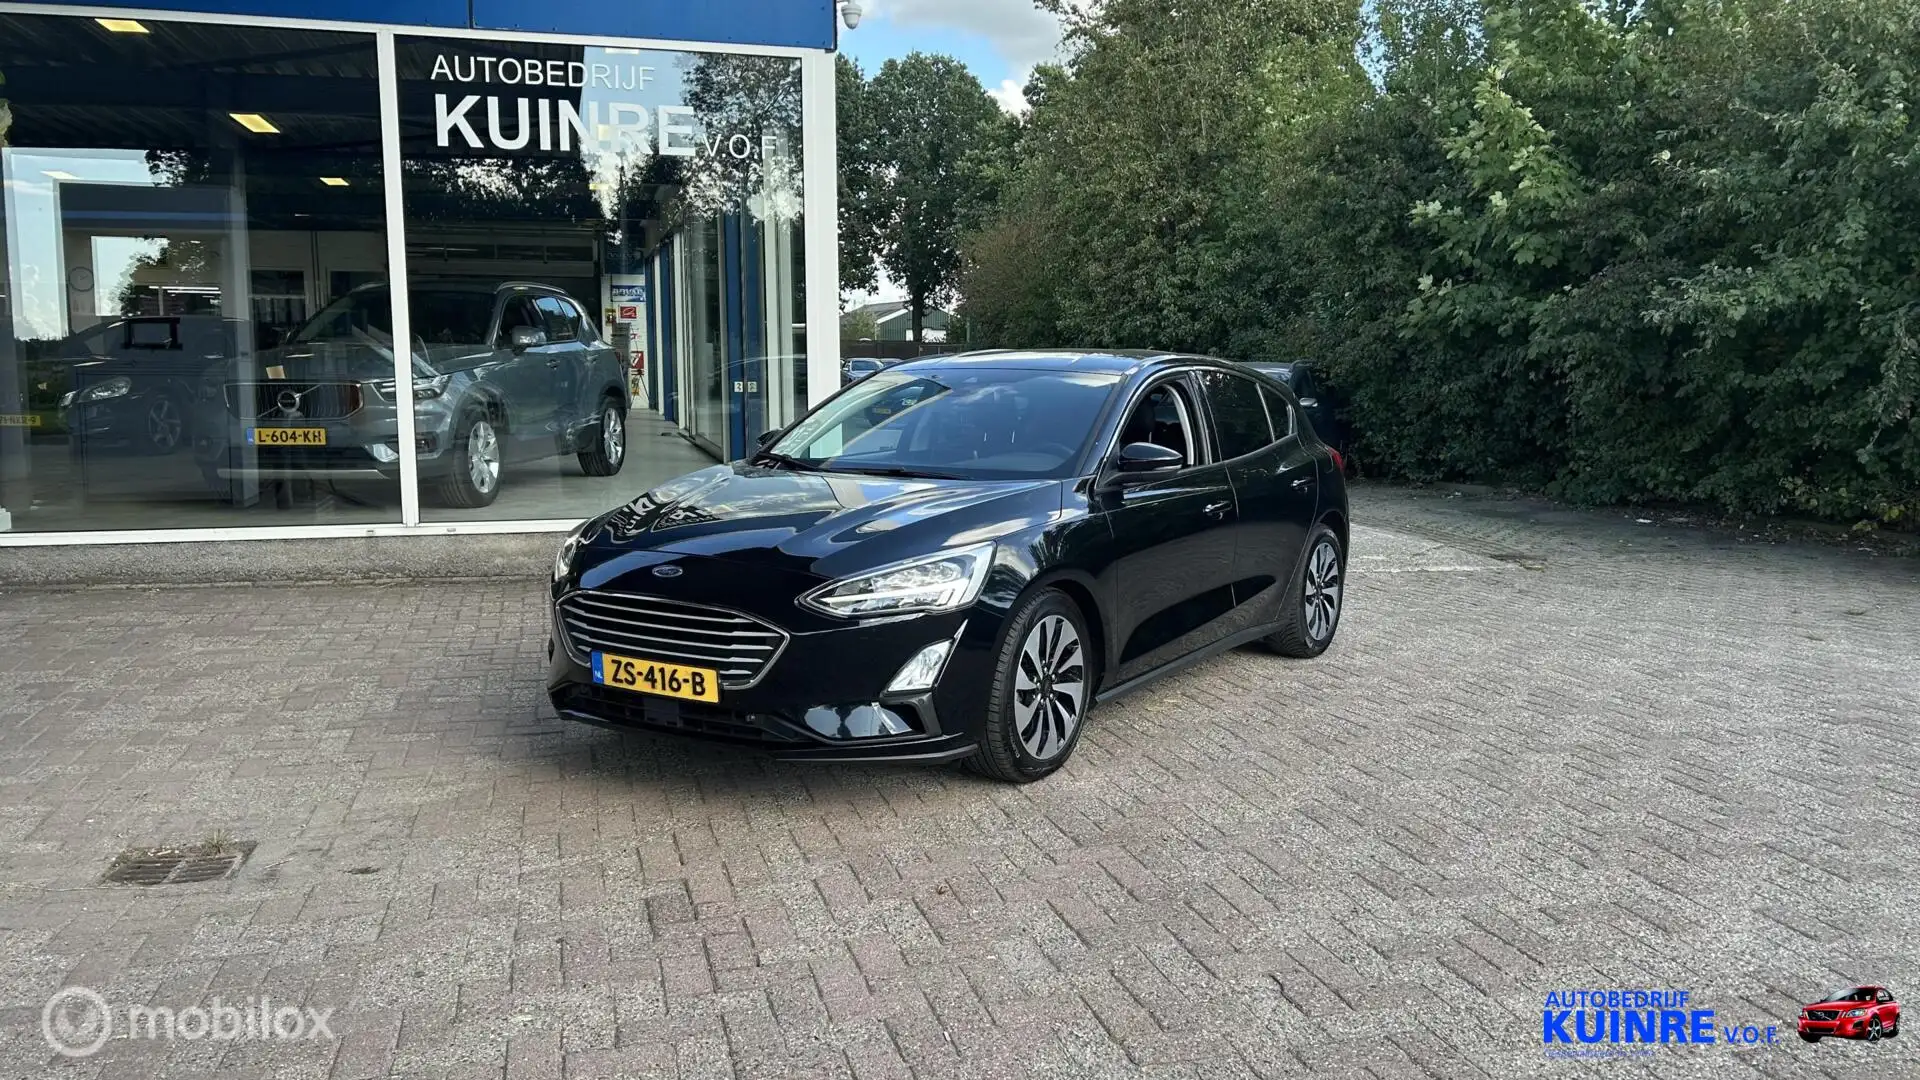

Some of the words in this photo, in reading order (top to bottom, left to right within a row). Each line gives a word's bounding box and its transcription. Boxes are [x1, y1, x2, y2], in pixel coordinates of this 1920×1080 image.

[430, 54, 656, 91] AUTOBEDRIJF
[433, 93, 697, 156] KUINRE
[258, 430, 322, 445] L-604-KH
[611, 659, 706, 696] ZS-416-B
